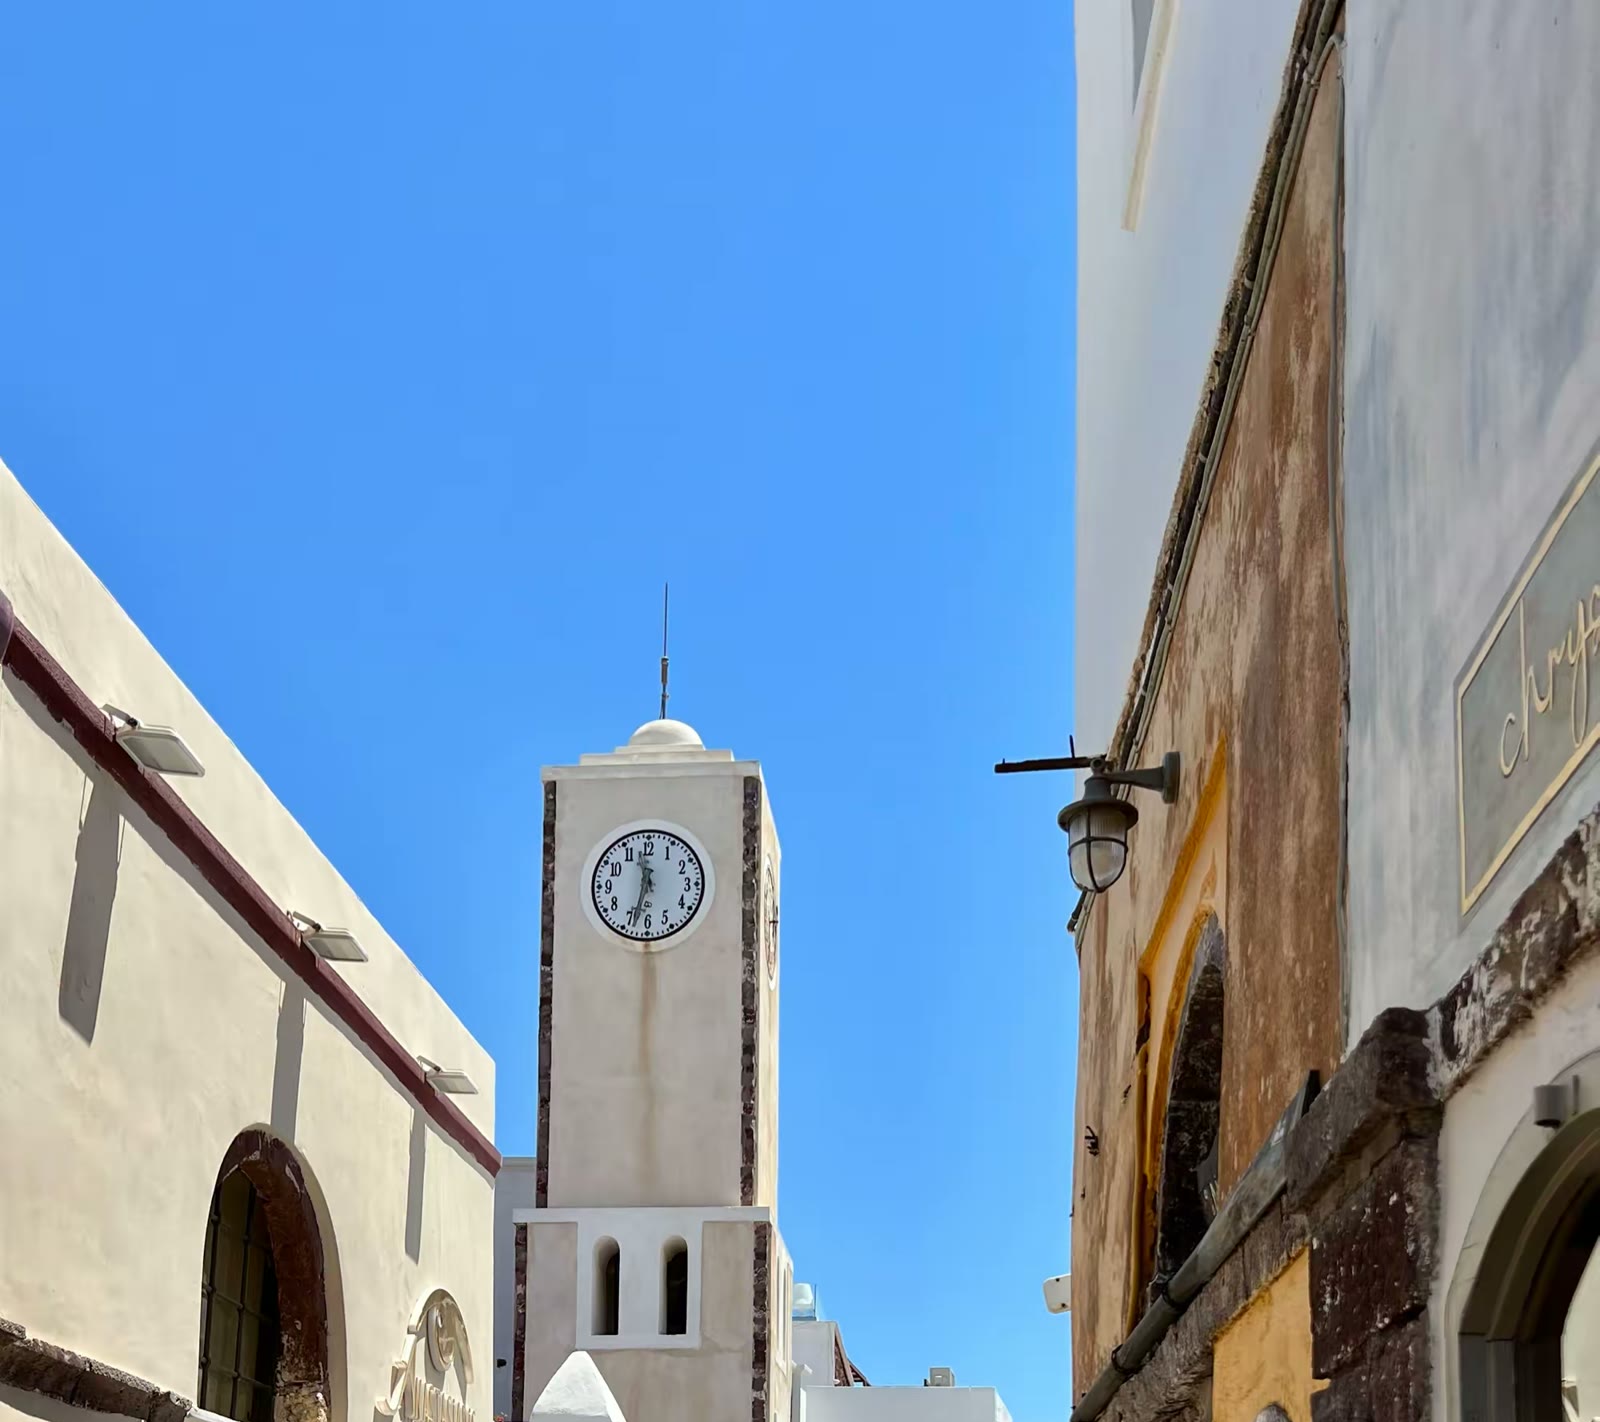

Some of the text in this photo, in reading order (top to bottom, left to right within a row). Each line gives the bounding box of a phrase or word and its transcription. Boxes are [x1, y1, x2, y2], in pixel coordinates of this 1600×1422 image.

[624, 847, 634, 862] 11
[643, 841, 654, 857] 12
[665, 846, 670, 860] 1
[610, 861, 622, 877] 10
[678, 860, 686, 875] 2
[604, 879, 612, 894] 9
[683, 877, 691, 892] 3
[610, 896, 618, 911] 8
[678, 894, 685, 909] 4
[626, 910, 633, 926] 7
[644, 914, 652, 929] 6
[661, 909, 669, 925] 5
